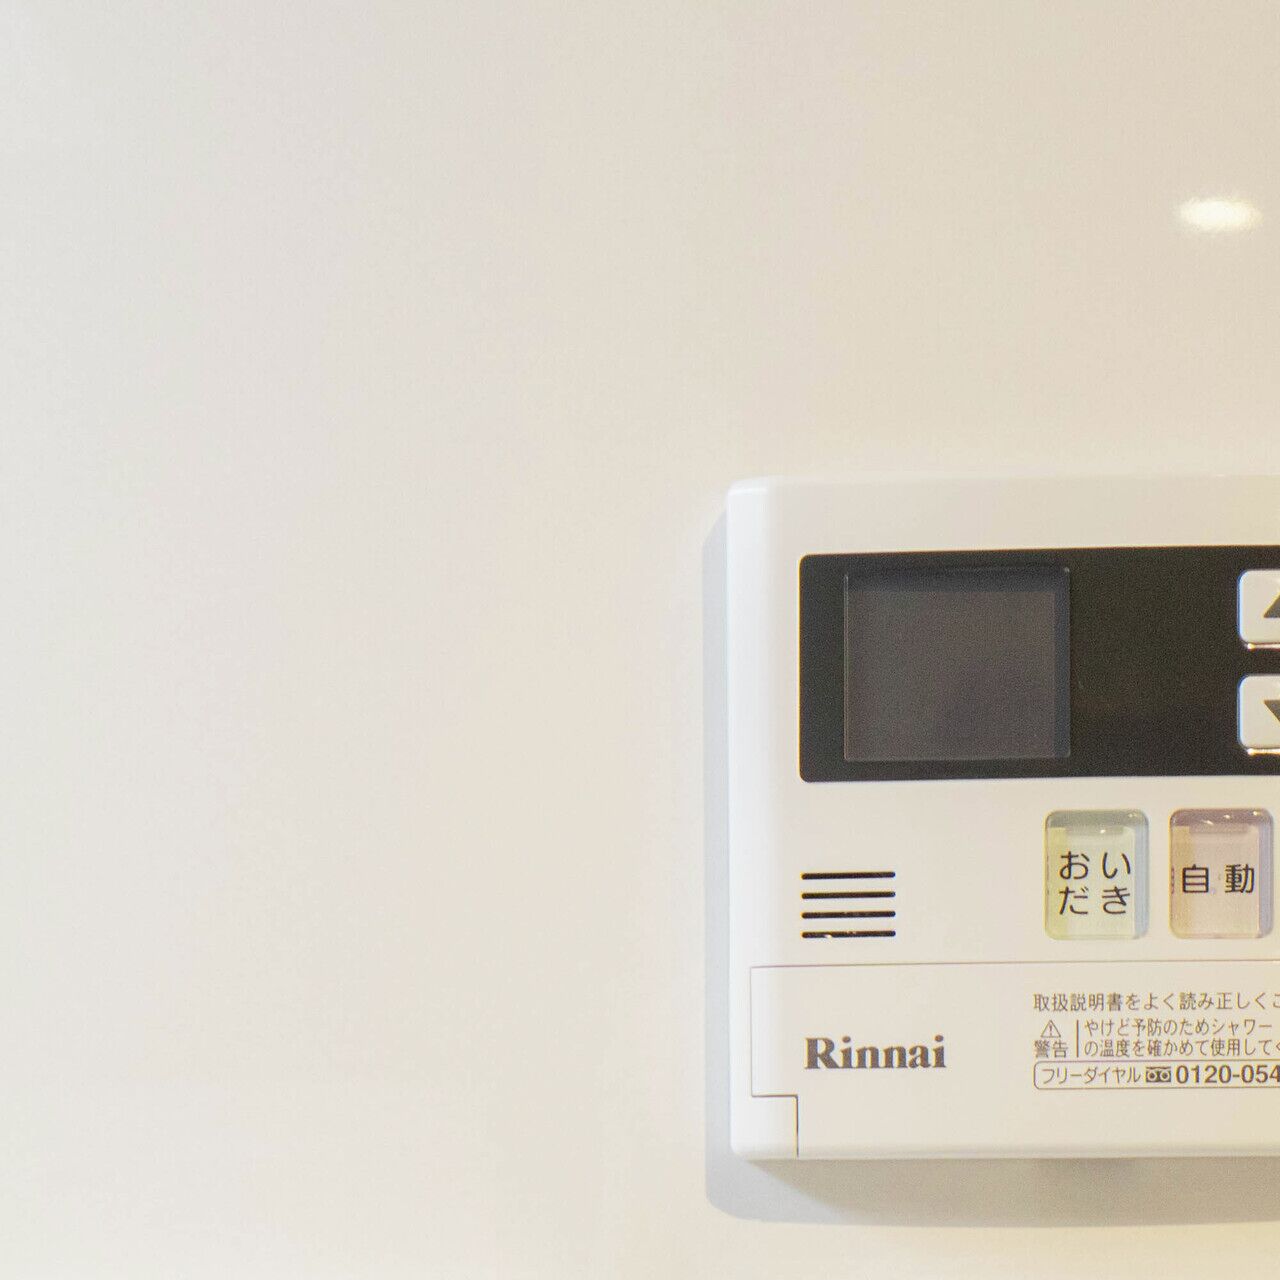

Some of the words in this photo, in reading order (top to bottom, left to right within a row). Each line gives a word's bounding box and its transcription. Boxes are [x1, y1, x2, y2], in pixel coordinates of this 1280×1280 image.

[804, 1034, 946, 1070] Rinnai
[1033, 1039, 1068, 1058] 警告
[1041, 1066, 1142, 1085] フリーダイヤル
